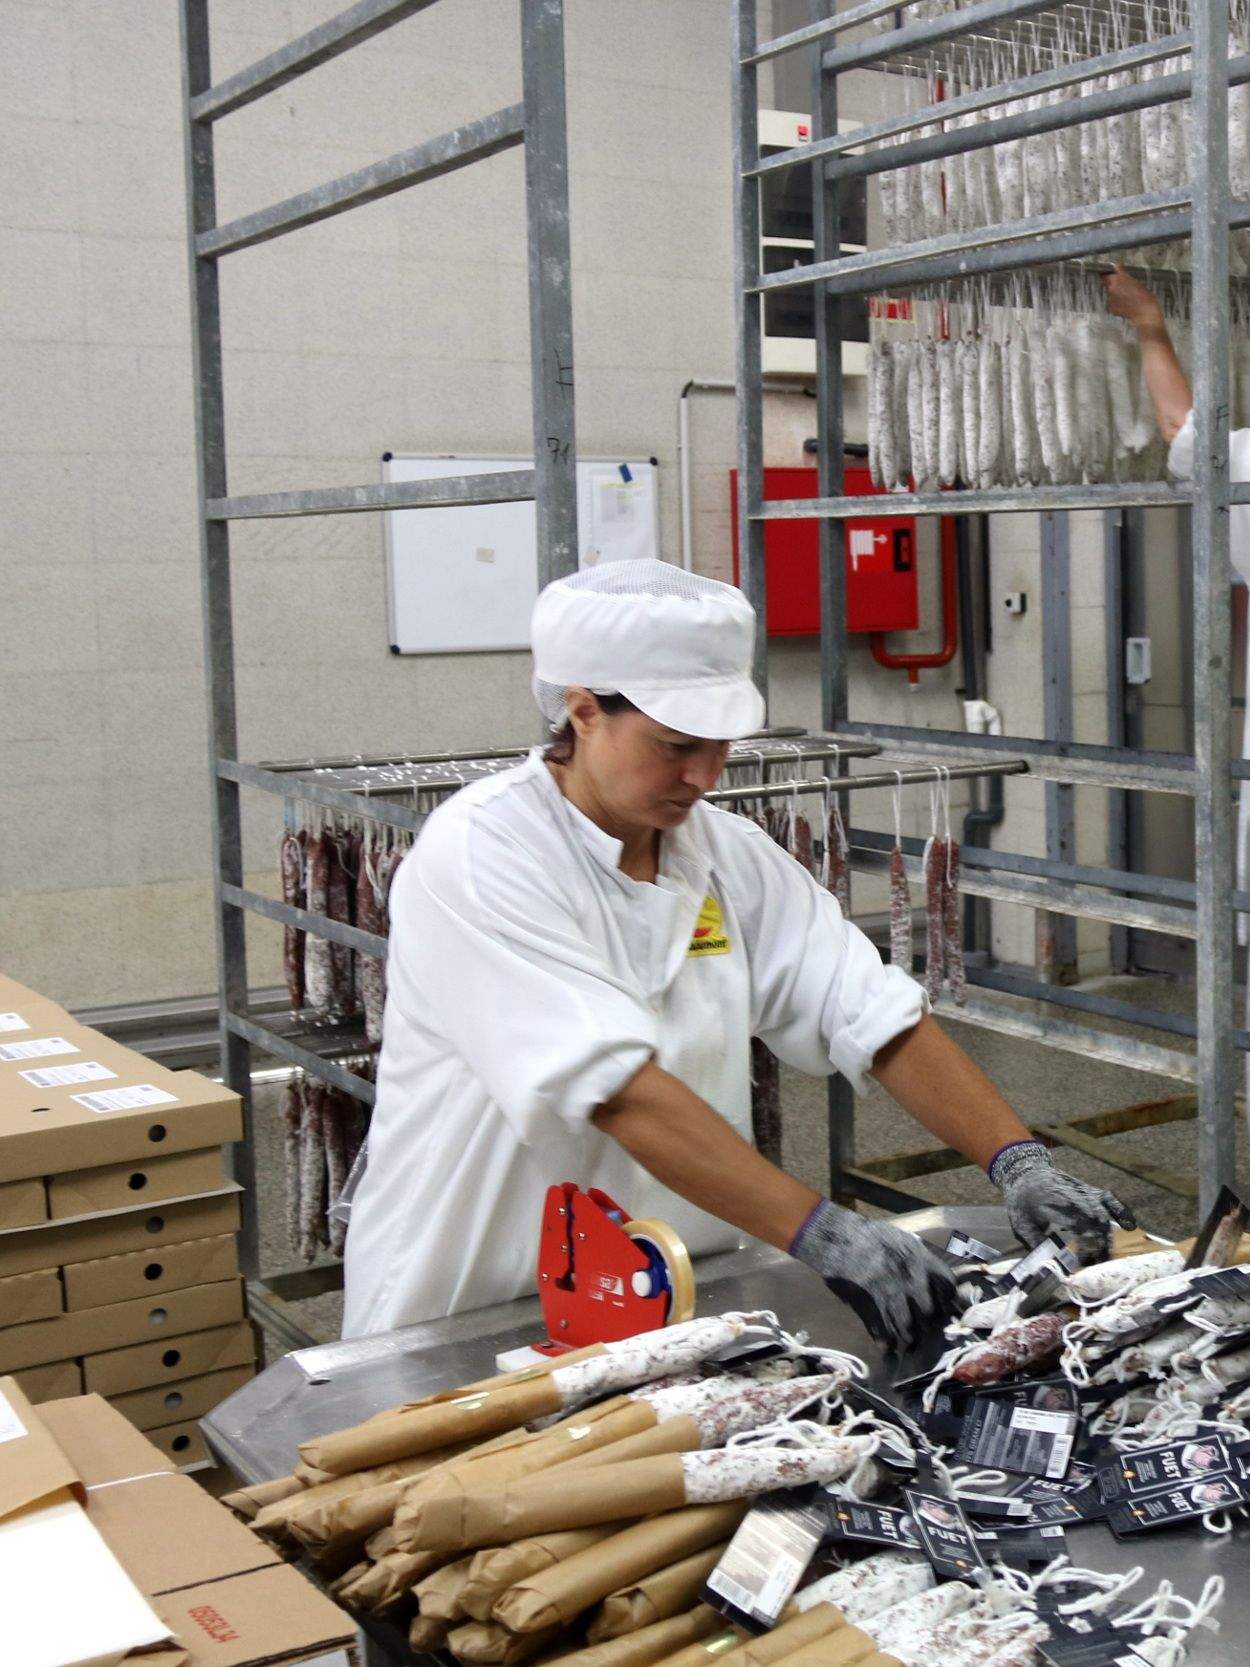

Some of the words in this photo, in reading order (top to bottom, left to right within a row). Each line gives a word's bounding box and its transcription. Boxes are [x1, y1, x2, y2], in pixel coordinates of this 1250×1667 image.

[1160, 1451, 1182, 1478] FUET
[1032, 1479, 1076, 1493] FUET
[1168, 1491, 1194, 1512] FUET
[877, 1509, 899, 1540] FUET
[927, 1526, 967, 1545] FUET
